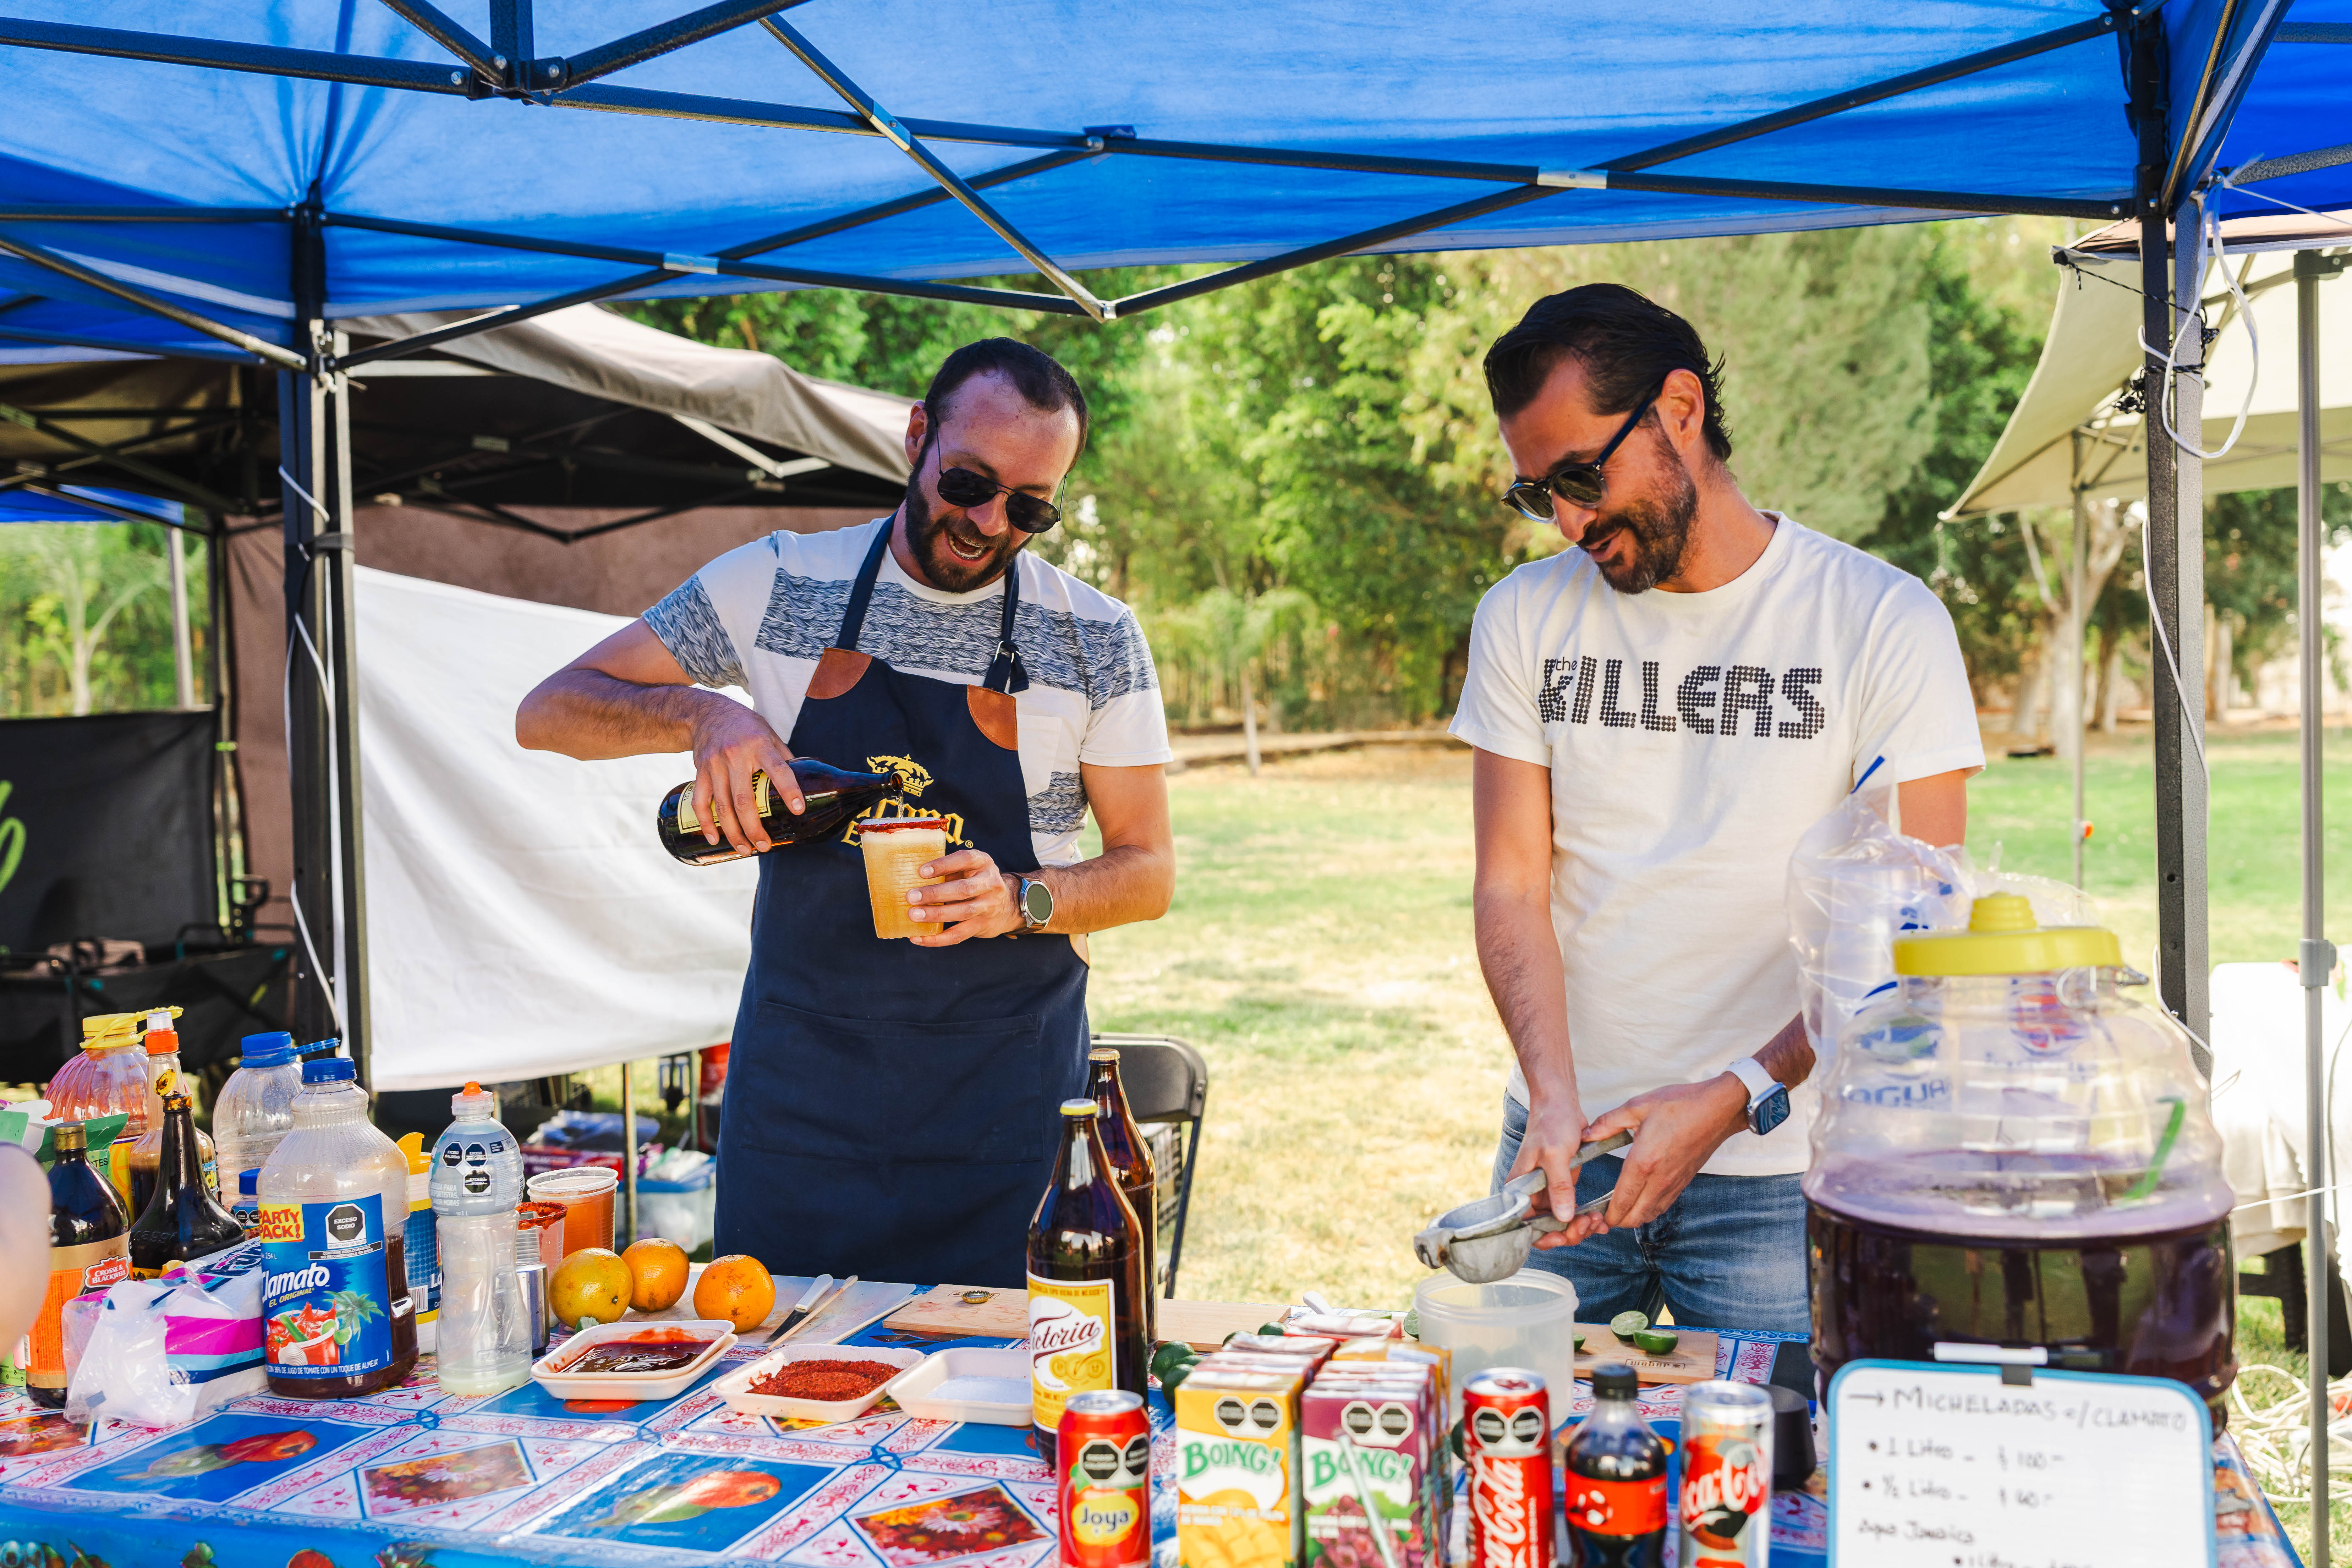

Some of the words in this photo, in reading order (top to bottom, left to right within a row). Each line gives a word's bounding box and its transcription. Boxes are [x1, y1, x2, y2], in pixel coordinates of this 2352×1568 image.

[1554, 658, 1578, 671] the
[1539, 655, 1825, 739] KILLERS
[90, 1158, 108, 1168] TES
[92, 1269, 126, 1284] BLACKWELL
[94, 1266, 119, 1277] CROSSE
[269, 1299, 277, 1307] EL
[338, 1365, 354, 1374] TOQUE
[355, 1363, 361, 1371] DE
[1894, 1386, 2056, 1421] MICHELADAS
[1182, 1441, 1283, 1479] BOING!
[1310, 1449, 1415, 1490] BONG!
[1082, 1506, 1129, 1532] Joya
